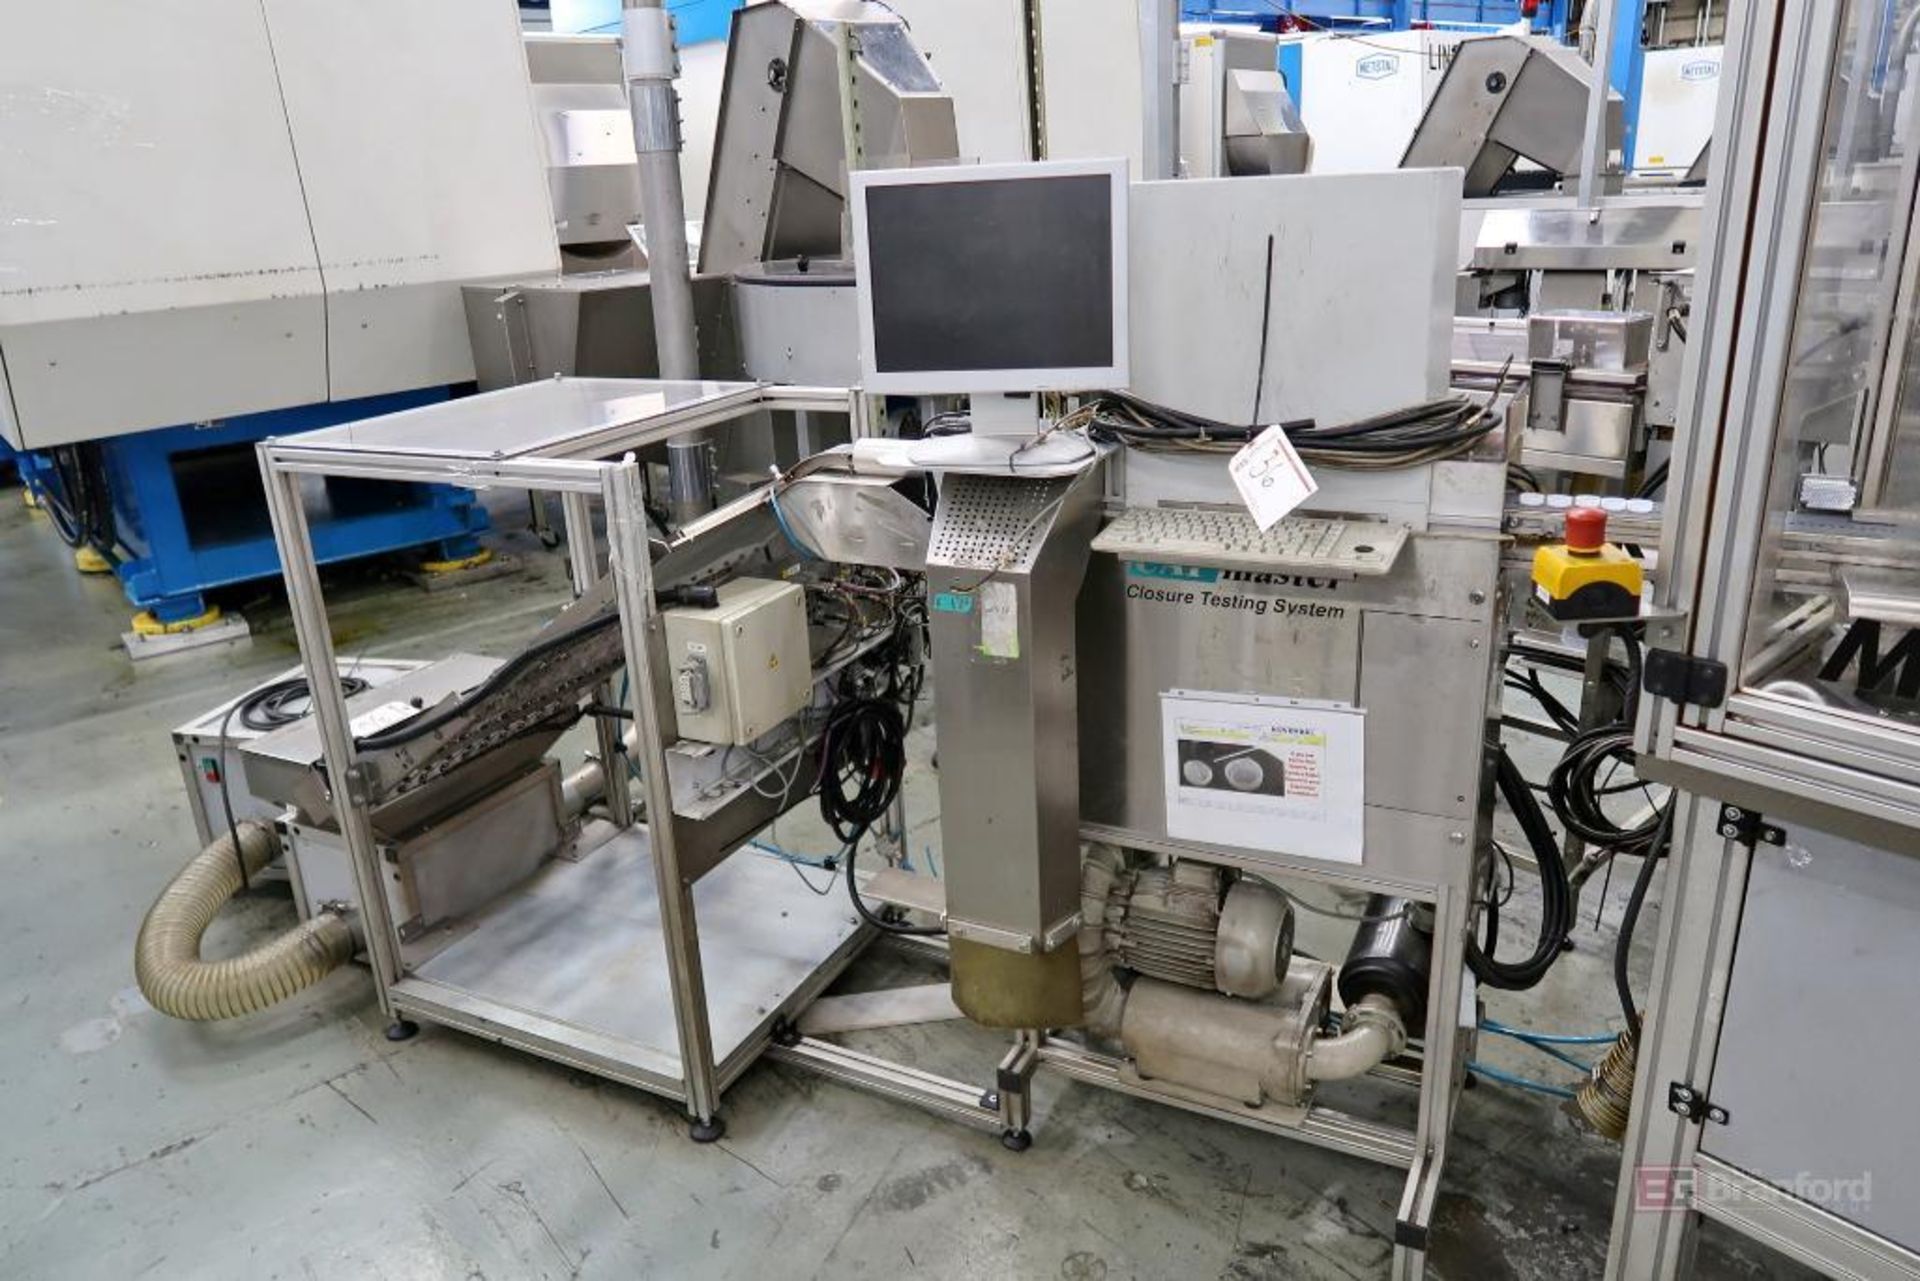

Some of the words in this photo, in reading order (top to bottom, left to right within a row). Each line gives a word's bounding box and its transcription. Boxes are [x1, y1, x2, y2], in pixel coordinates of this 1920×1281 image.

[1429, 43, 1459, 70] LIN
[1127, 583, 1194, 604] Closure
[1201, 591, 1268, 615] Testing
[1273, 598, 1345, 619] System
